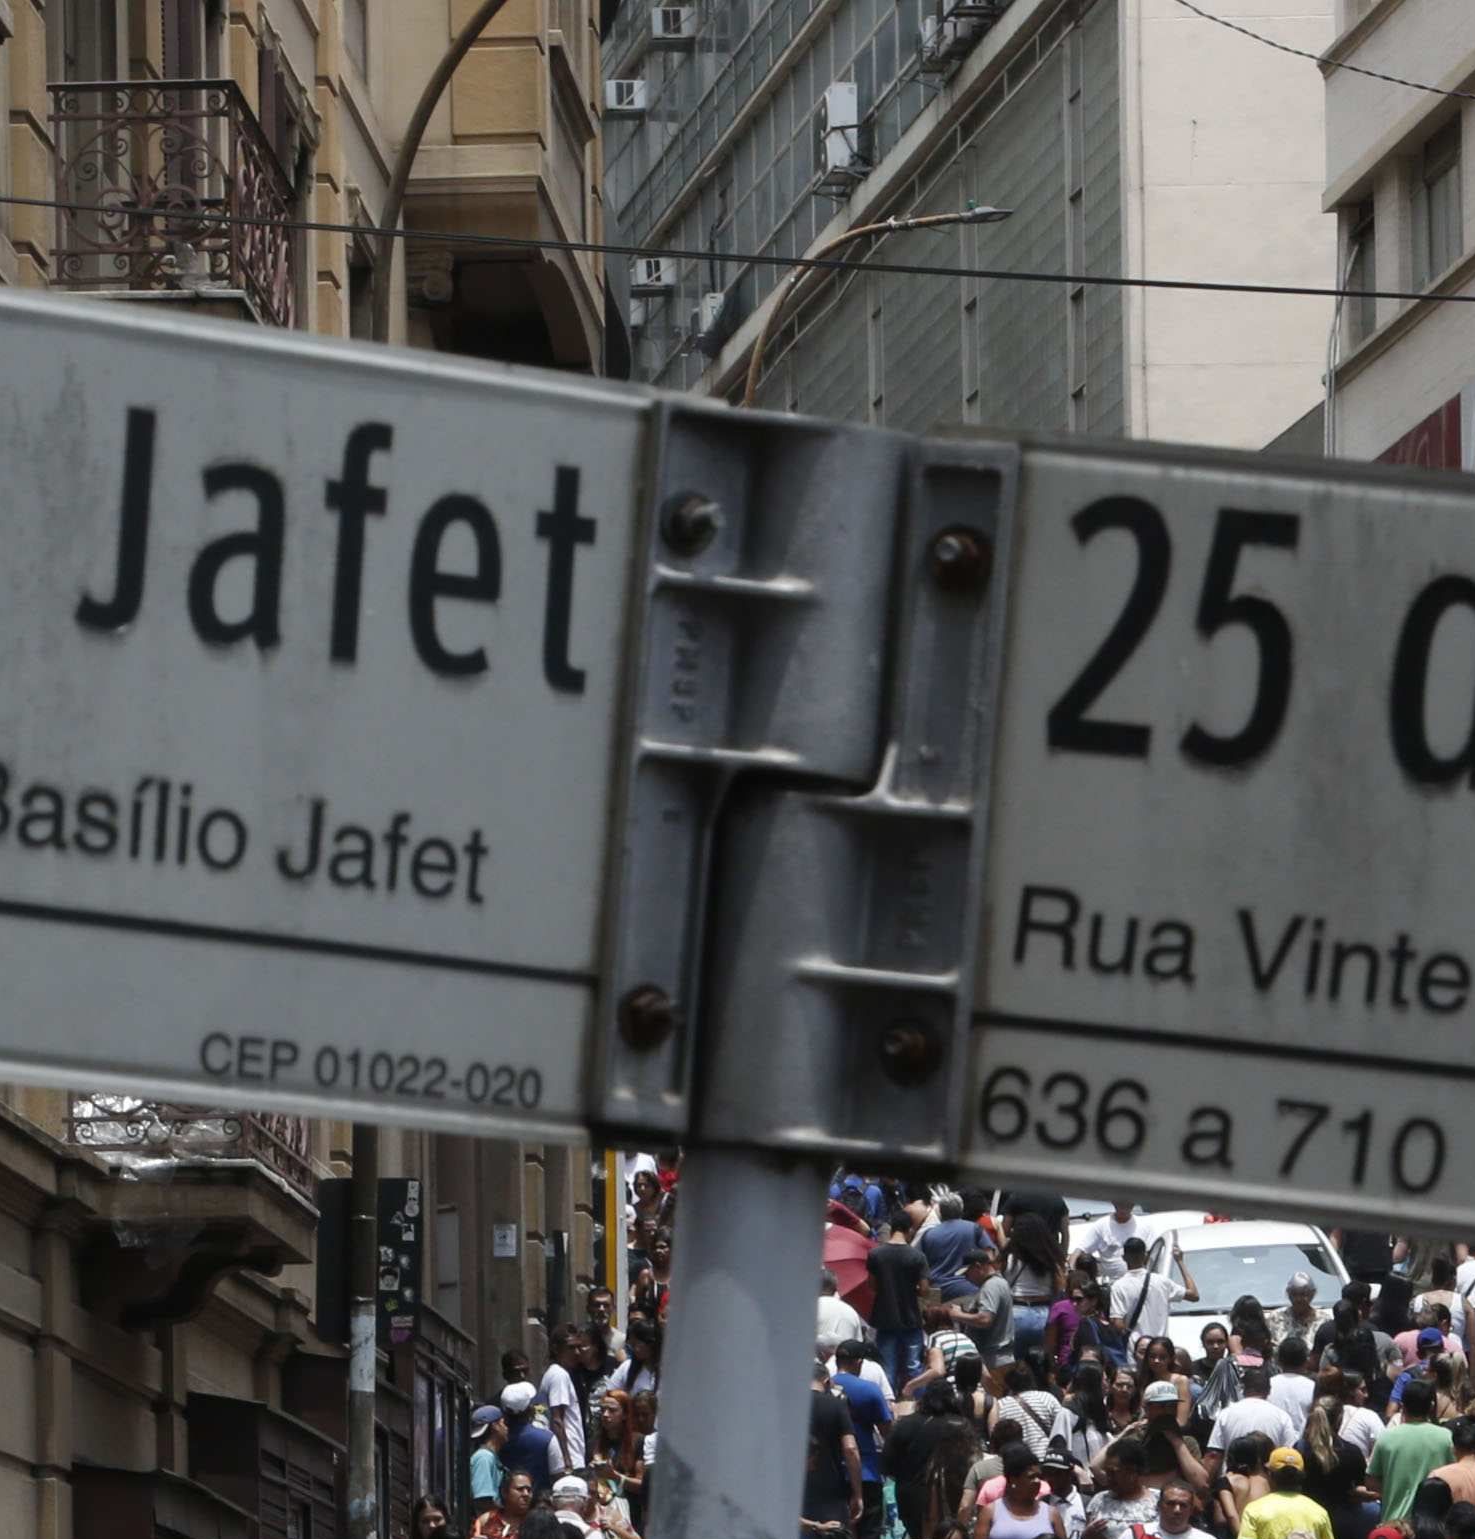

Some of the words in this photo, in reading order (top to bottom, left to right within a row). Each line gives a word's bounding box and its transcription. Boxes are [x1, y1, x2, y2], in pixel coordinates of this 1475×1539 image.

[74, 407, 598, 695] Jafet
[1047, 495, 1300, 770] 25
[277, 799, 487, 903] Jafet
[1012, 886, 1196, 982] Rua
[1238, 909, 1471, 1014] Vinte
[199, 1032, 299, 1080] CEP
[314, 1046, 543, 1109] 01022-020
[979, 1066, 1149, 1157] 636
[1182, 1106, 1233, 1170] a
[1276, 1098, 1445, 1195] 710
